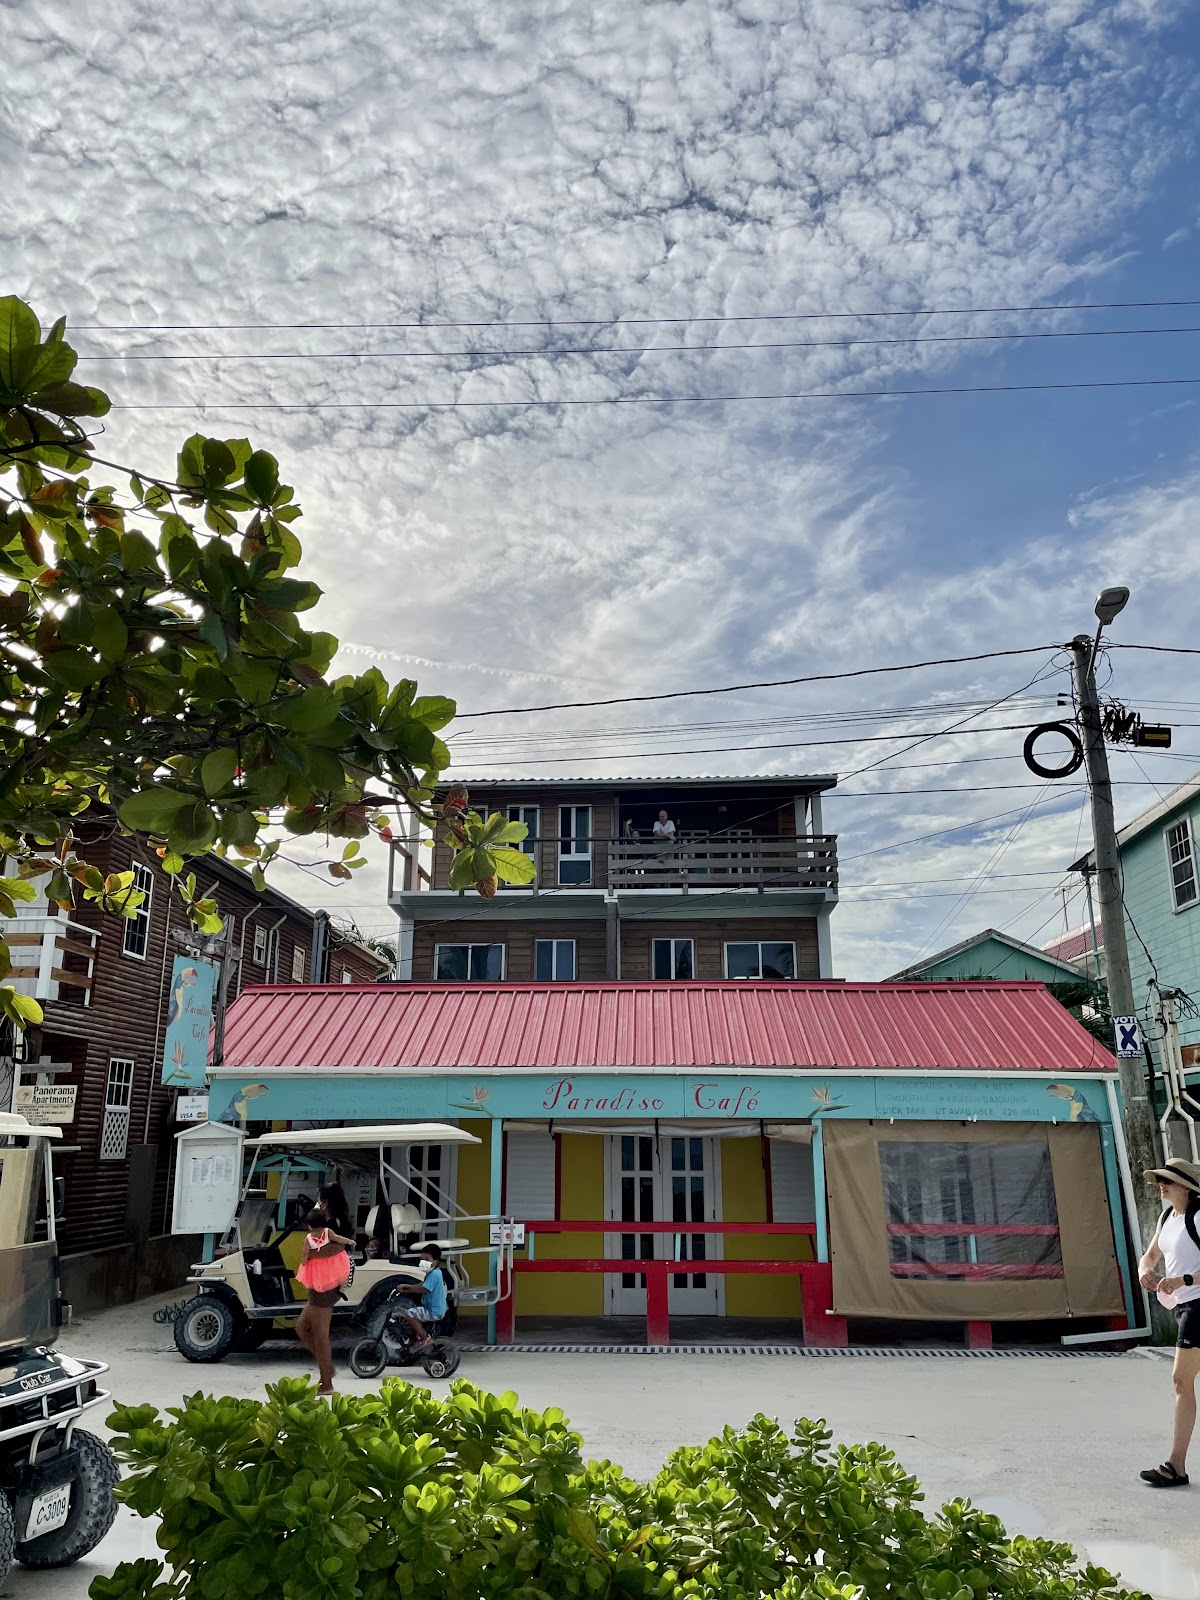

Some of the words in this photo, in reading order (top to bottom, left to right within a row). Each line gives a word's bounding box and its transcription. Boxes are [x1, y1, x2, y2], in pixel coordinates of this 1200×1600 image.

[184, 996, 211, 1017] Paradiso
[33, 1086, 75, 1095] Panorama
[896, 1081, 944, 1090] COCKTAILS
[956, 1082, 980, 1090] WINE
[992, 1082, 1015, 1091] BEER
[31, 1096, 74, 1105] Apartments
[542, 1076, 664, 1110] Paradiso
[691, 1083, 761, 1117] Café
[982, 1095, 1027, 1104] DAIQUIRIS
[877, 1106, 903, 1116] QUICK
[906, 1107, 927, 1116] TAKE
[949, 1107, 994, 1116] AVAILABLE
[20, 1378, 39, 1390] Club
[38, 1374, 52, 1384] Car
[36, 1497, 67, 1526] C-3009
